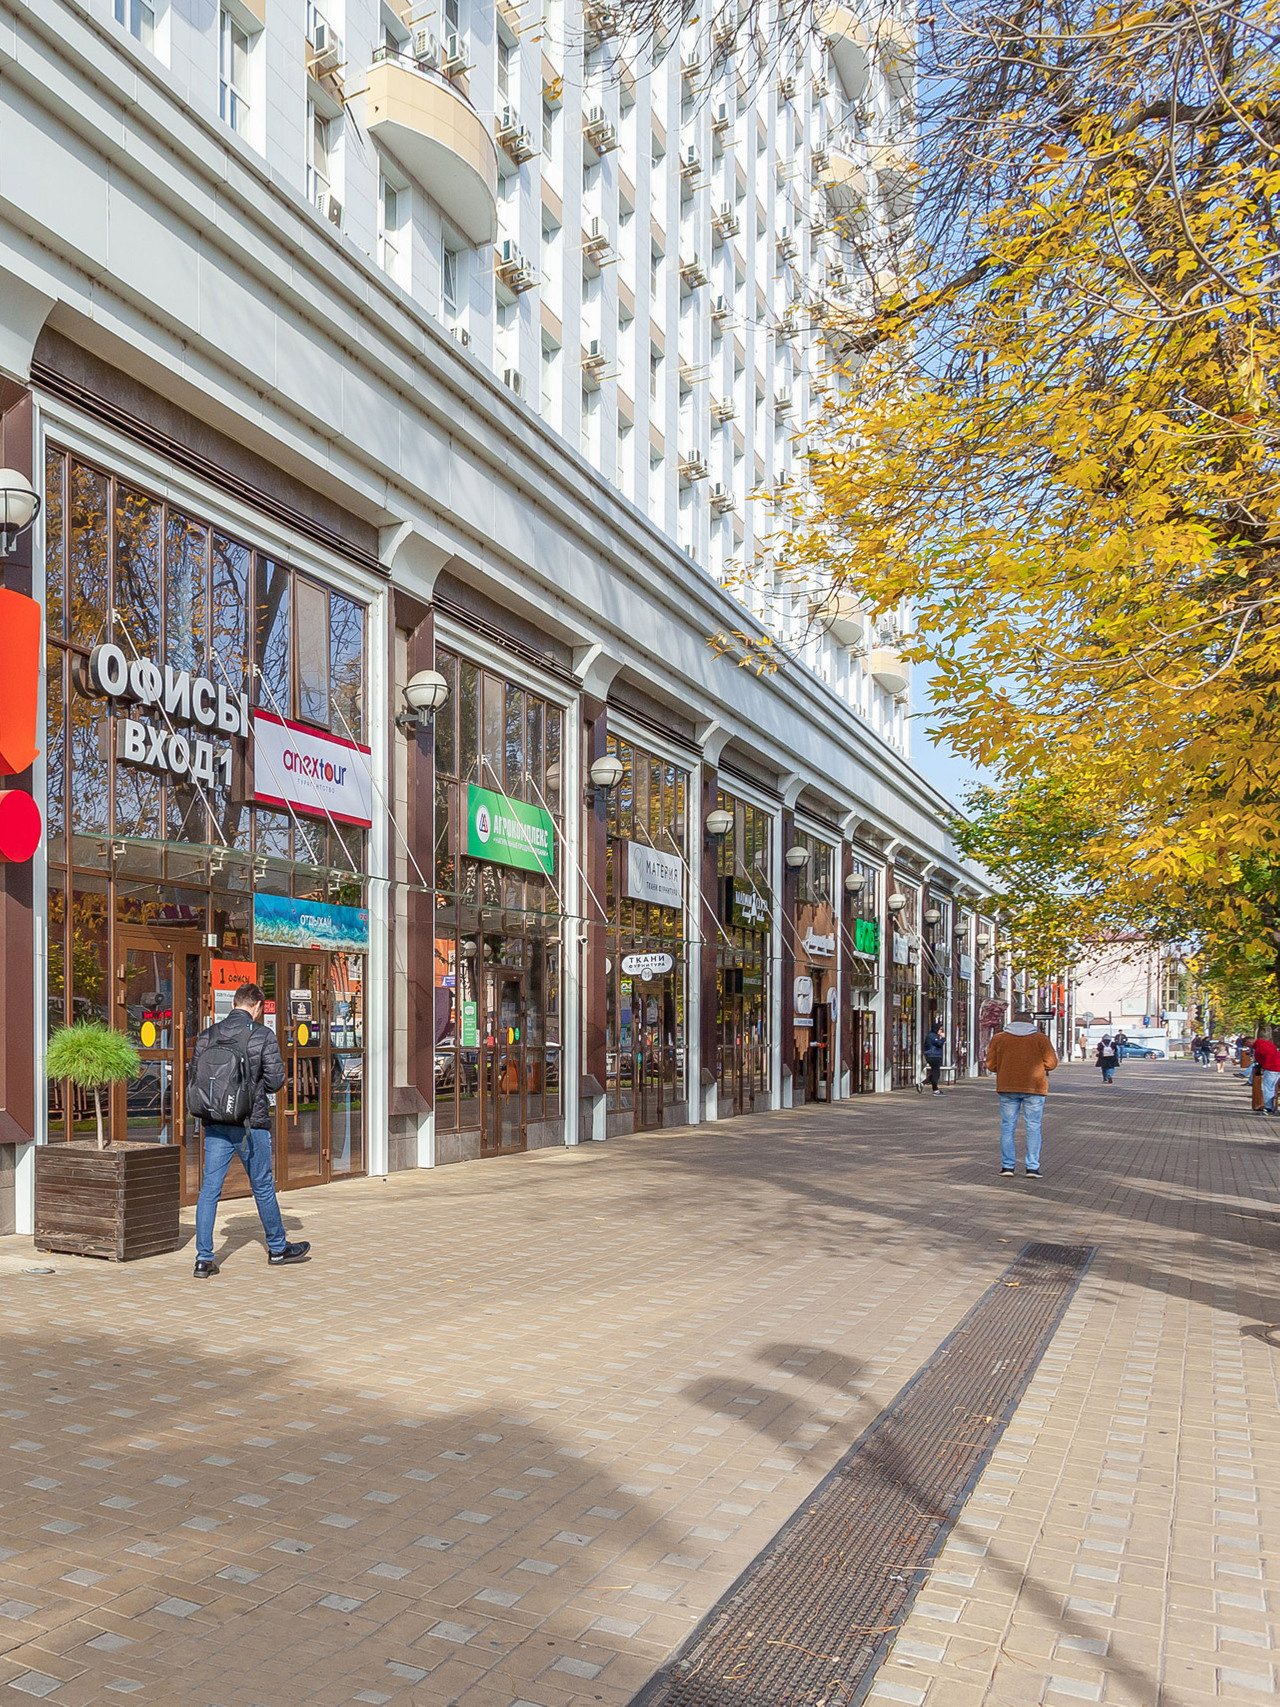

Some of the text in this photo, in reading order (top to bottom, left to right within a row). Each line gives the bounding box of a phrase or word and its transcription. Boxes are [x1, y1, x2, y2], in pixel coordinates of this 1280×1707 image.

[90, 643, 249, 738] ОФИСЫ
[283, 749, 347, 786] anextour
[645, 859, 678, 883] МАТЕРИЯ
[628, 955, 665, 964] ТКАНИ
